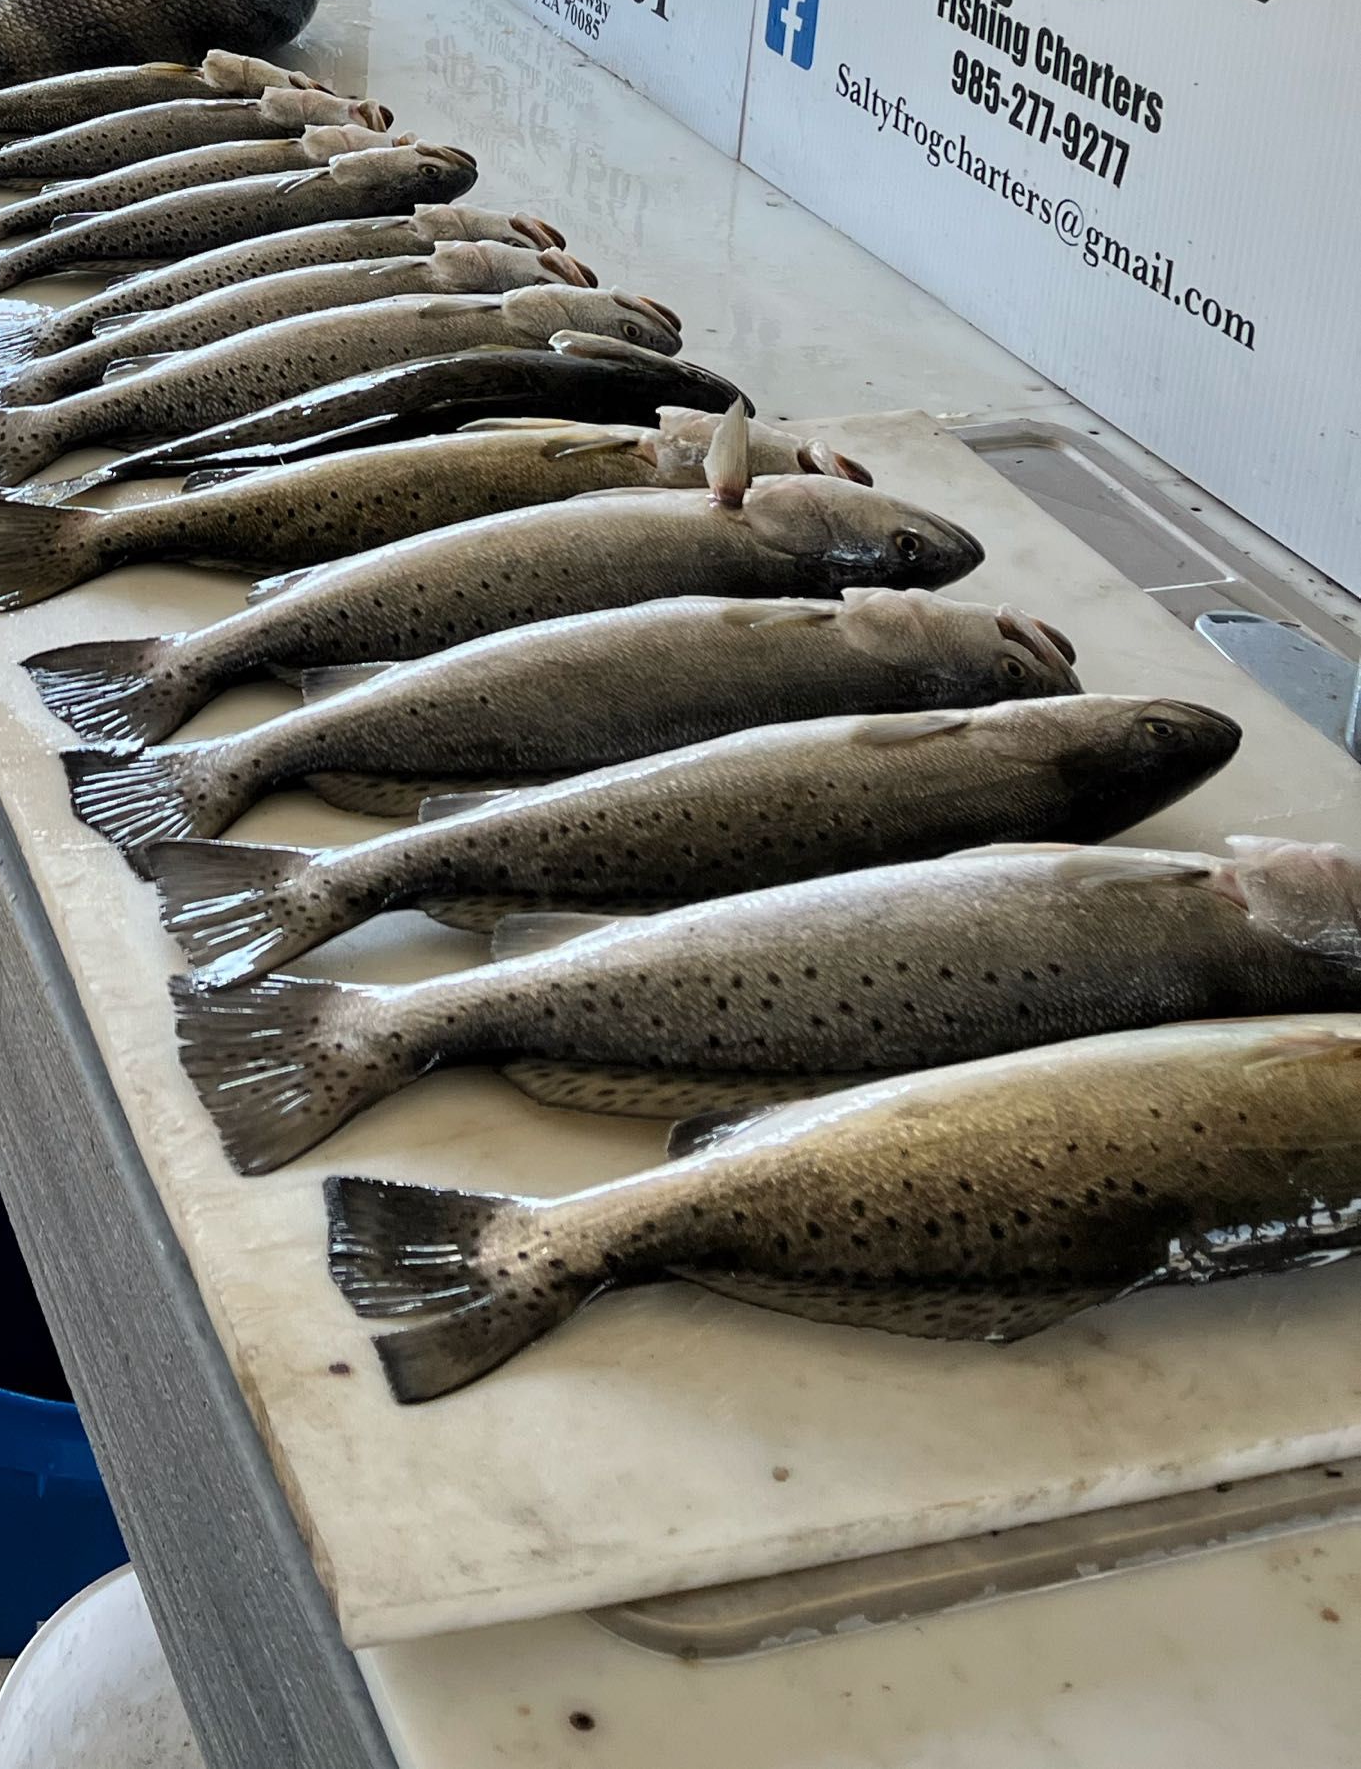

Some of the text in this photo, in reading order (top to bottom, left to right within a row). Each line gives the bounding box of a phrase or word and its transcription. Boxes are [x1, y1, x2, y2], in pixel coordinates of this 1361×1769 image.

[950, 48, 1131, 189] 985-277-9277
[1034, 25, 1165, 134] Charters
[834, 61, 1256, 352] Saltyfrogcharters@gmail.com
